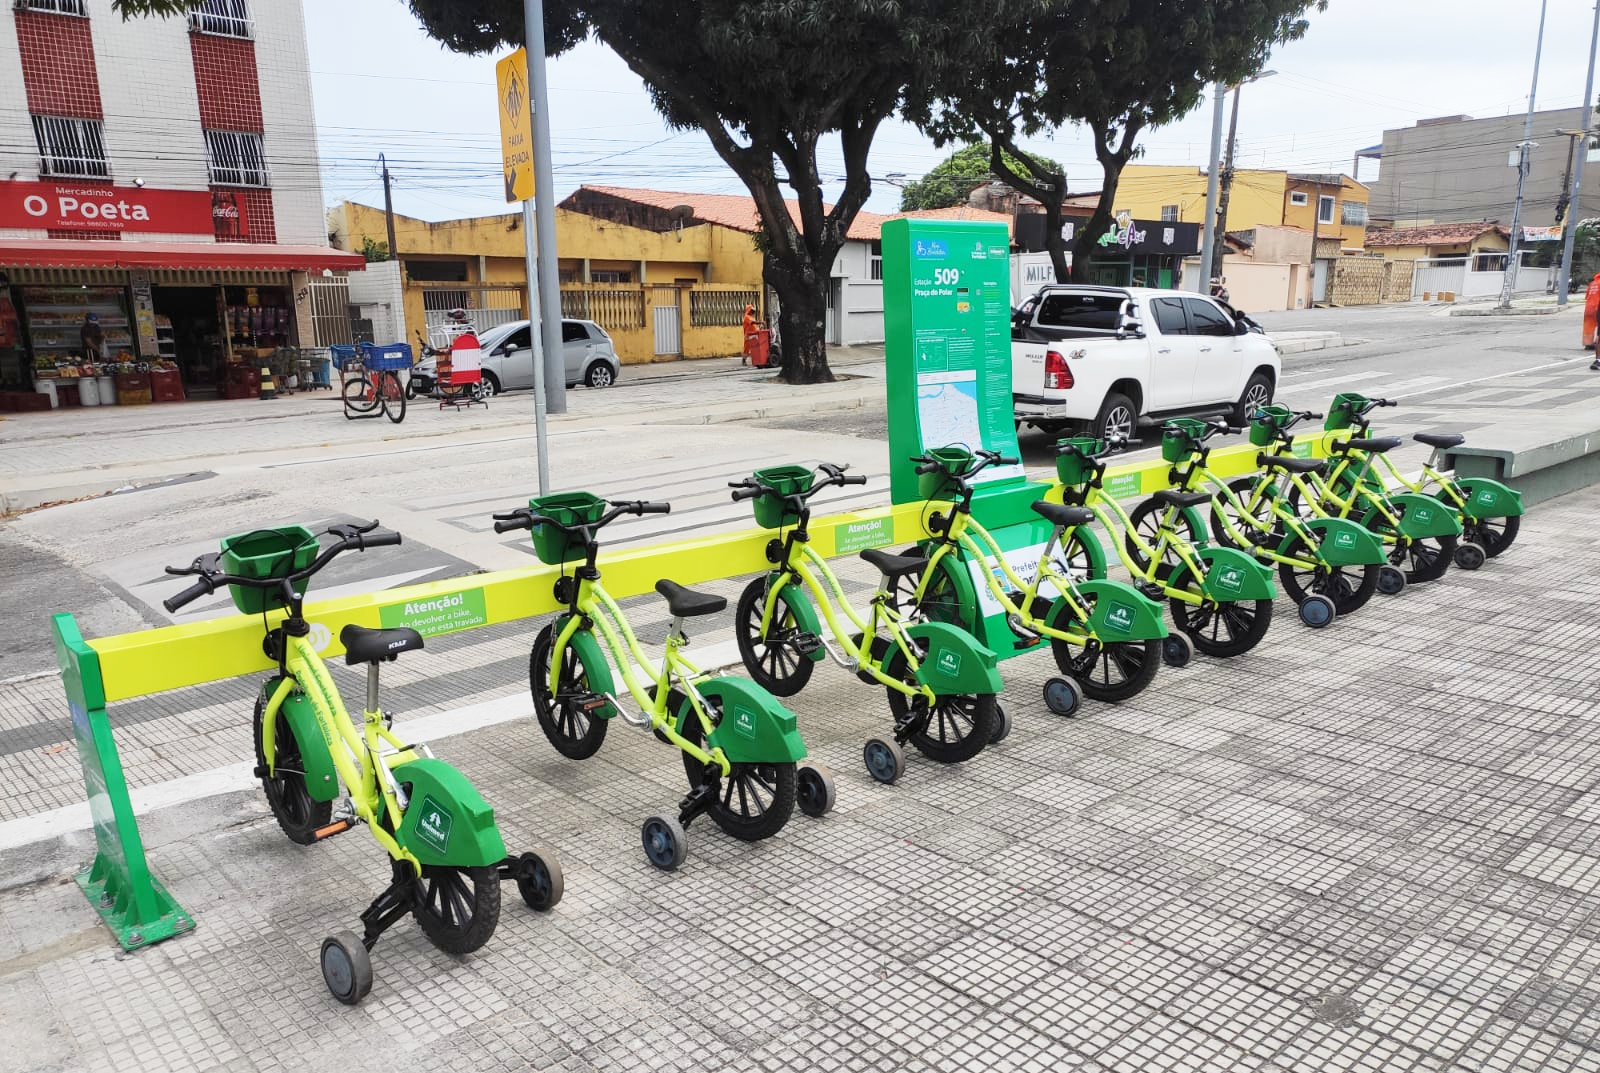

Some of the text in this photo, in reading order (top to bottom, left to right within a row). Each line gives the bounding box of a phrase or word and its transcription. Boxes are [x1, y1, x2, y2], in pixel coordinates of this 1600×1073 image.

[505, 151, 530, 168] ELEVADA
[55, 186, 114, 197] Mercadinho
[23, 195, 150, 221] O Poeta
[934, 268, 959, 286] 509
[914, 288, 930, 298] Praça
[848, 519, 882, 534] Atenção!
[404, 592, 464, 616] Atenção!
[411, 613, 445, 628] devolver
[447, 612, 452, 620] a
[455, 615, 483, 628] travada
